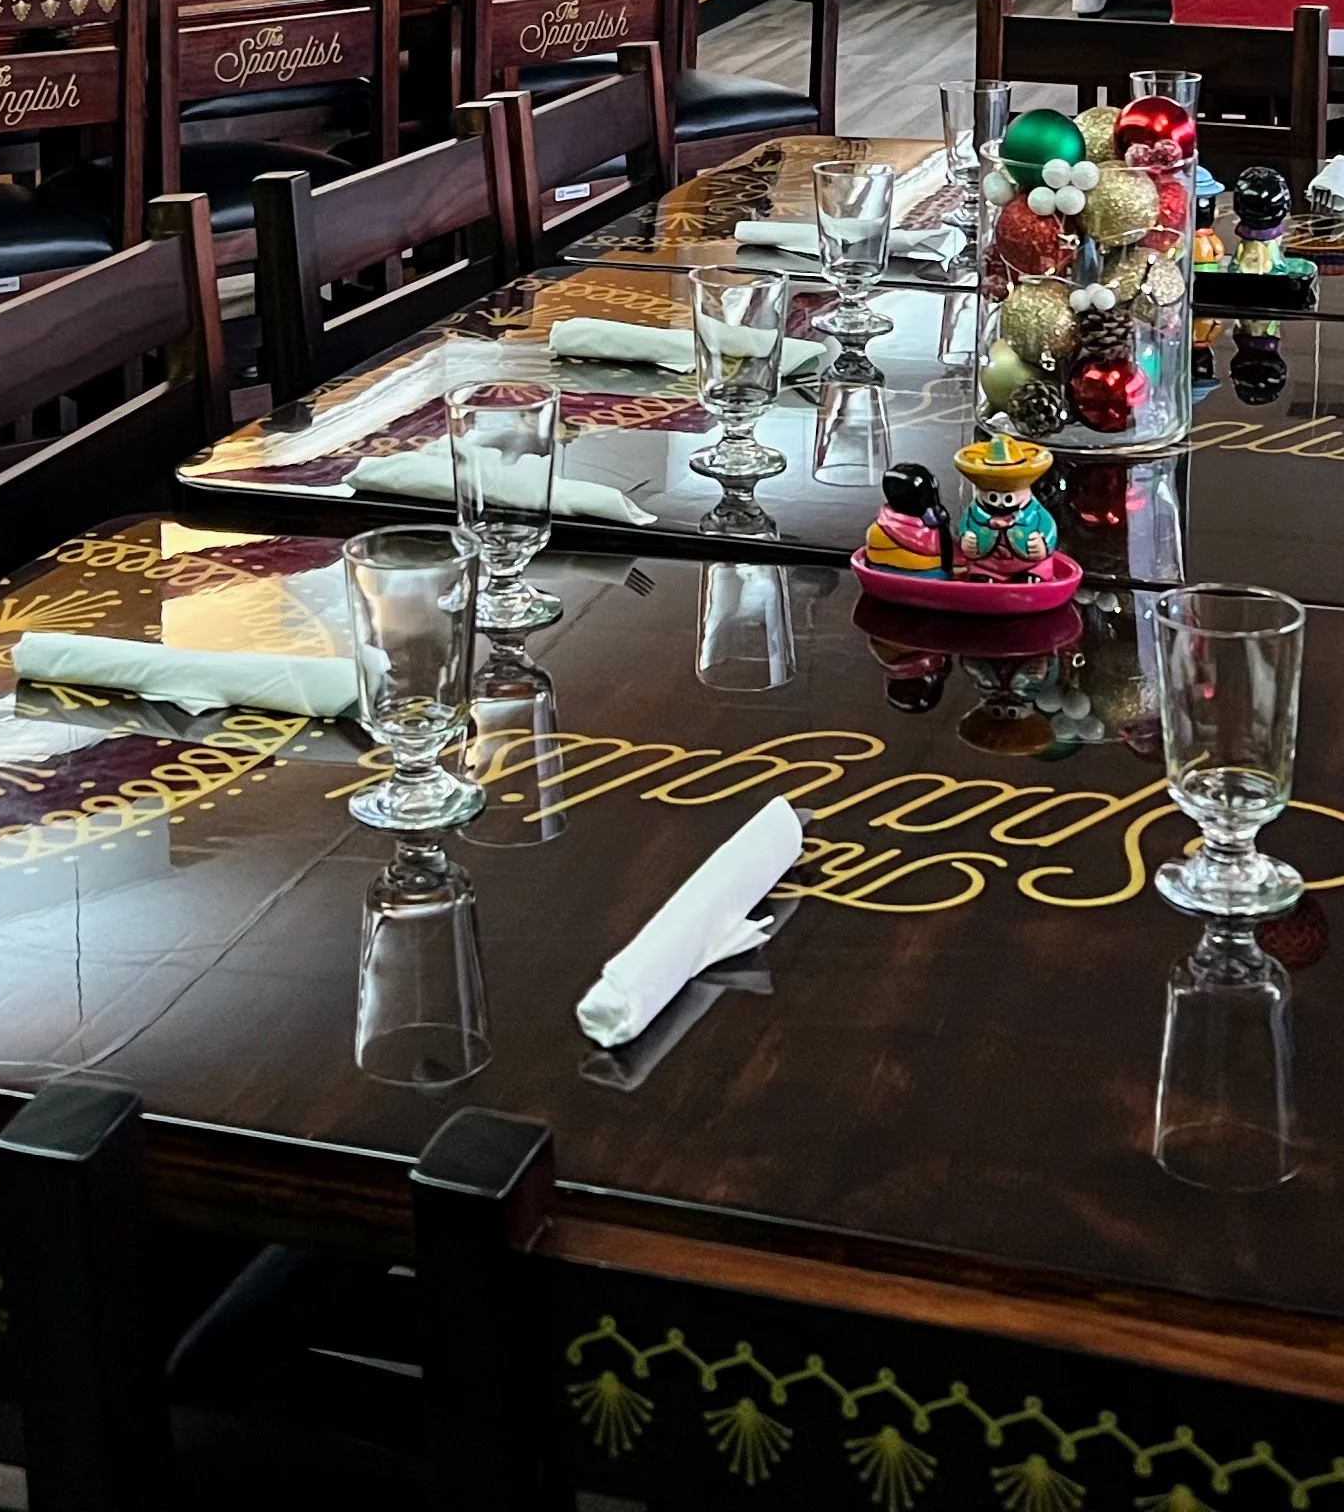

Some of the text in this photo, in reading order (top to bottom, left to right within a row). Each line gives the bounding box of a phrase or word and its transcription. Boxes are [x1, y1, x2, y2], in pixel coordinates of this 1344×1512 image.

[555, 0, 580, 23] The
[255, 25, 284, 50] The
[519, 5, 629, 59] Spanglish
[214, 31, 344, 89] Spanglish
